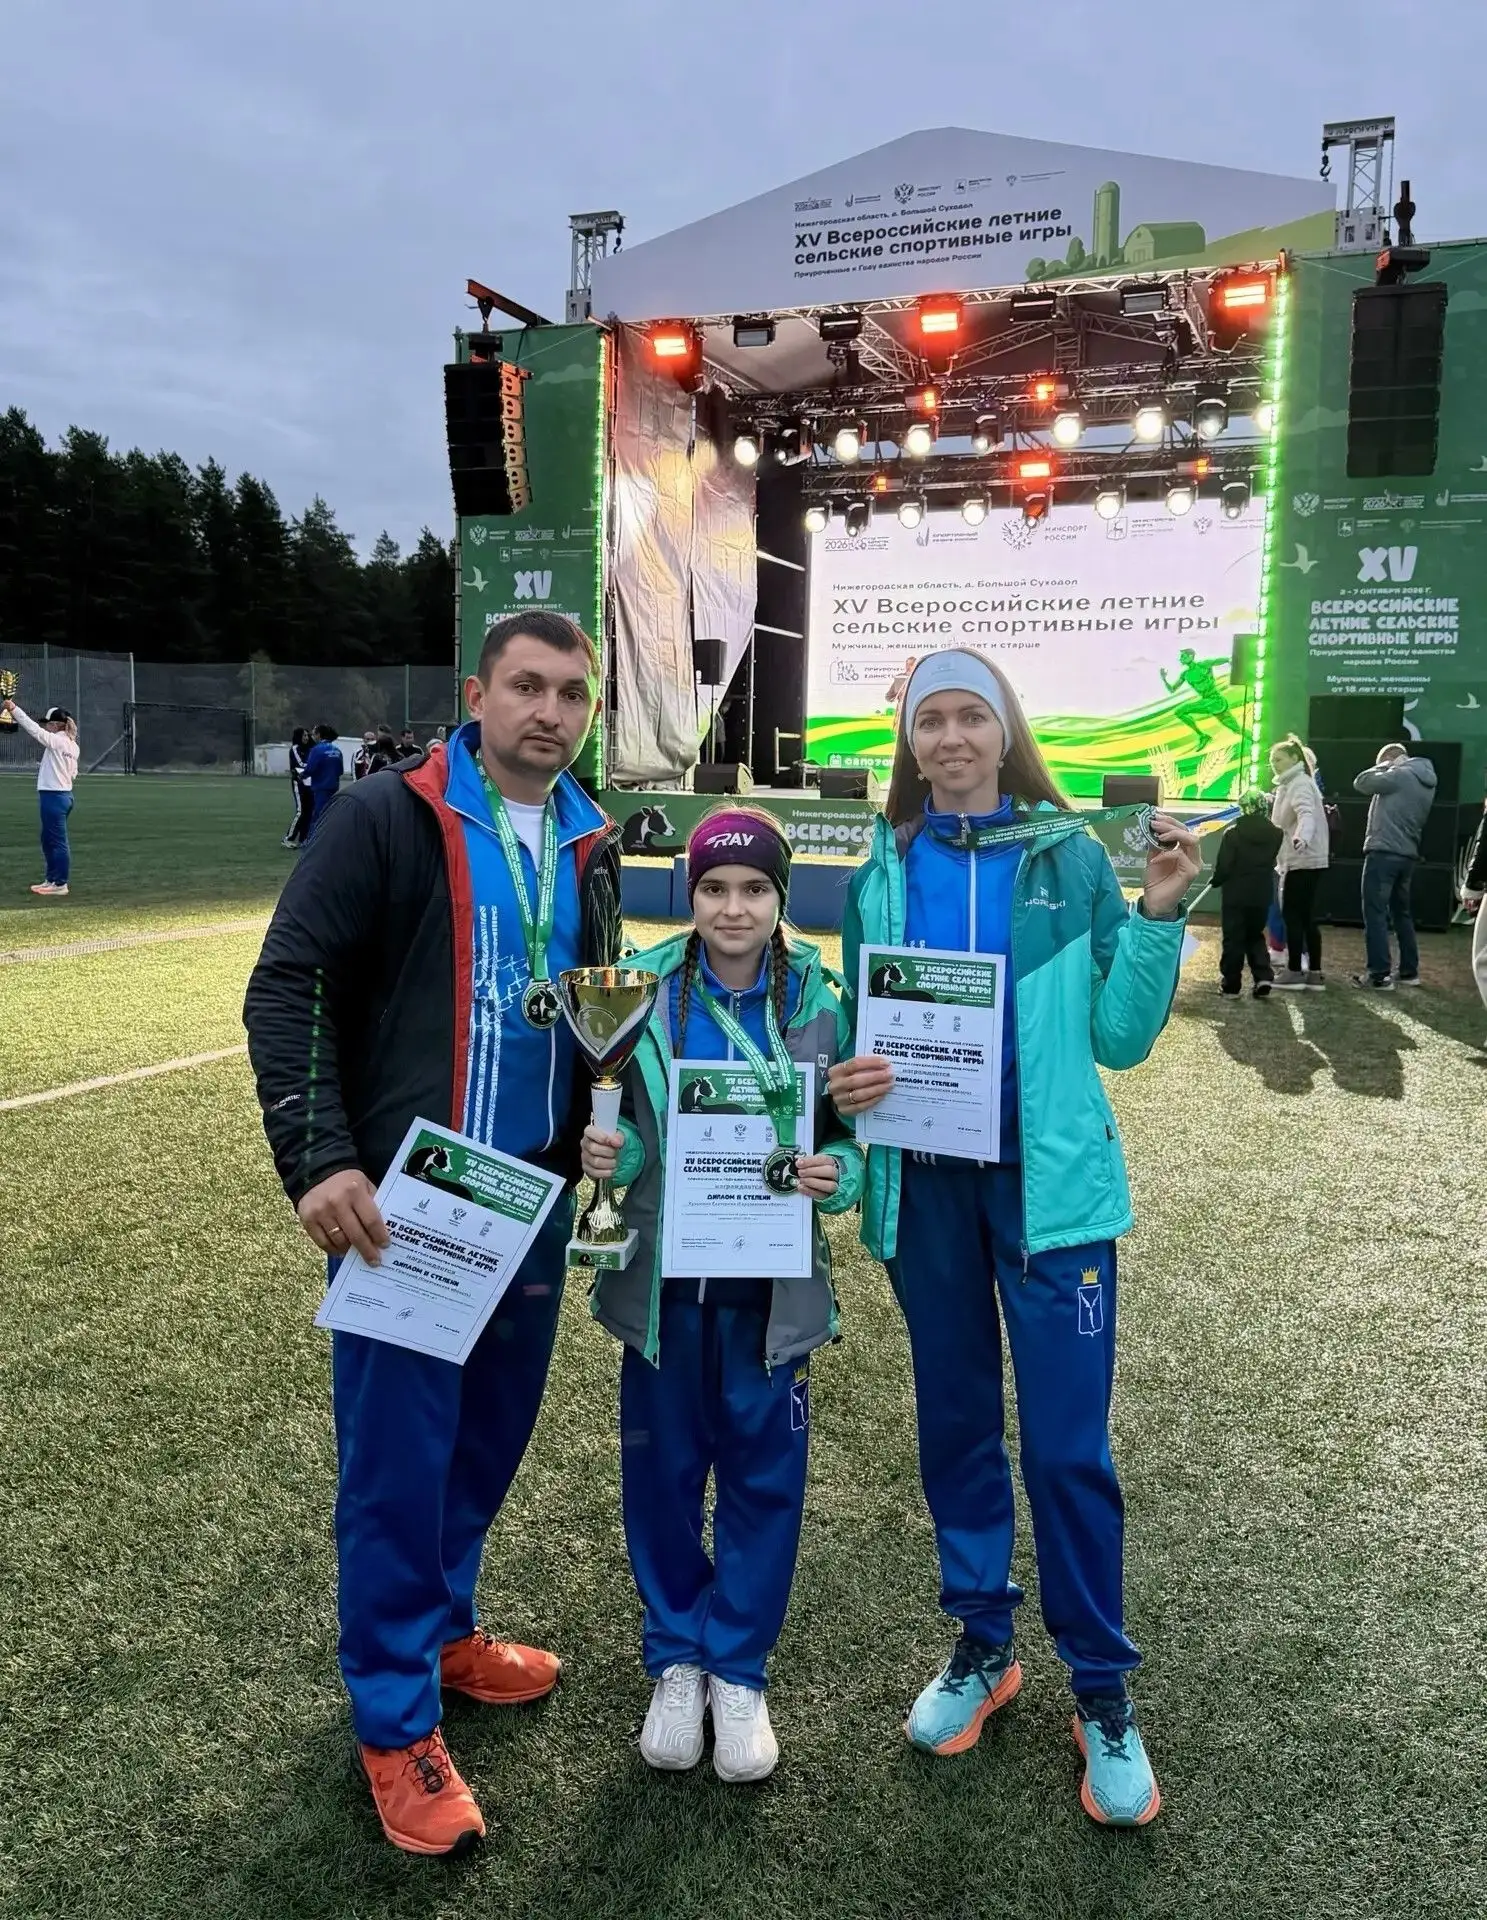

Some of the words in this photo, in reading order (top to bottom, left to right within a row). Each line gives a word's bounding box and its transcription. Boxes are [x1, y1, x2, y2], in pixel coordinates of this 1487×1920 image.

[795, 217, 855, 228] Нижегородская
[857, 213, 889, 222] область,
[901, 205, 936, 216] Большой
[939, 203, 973, 213] Суходол
[795, 232, 821, 248] XV
[827, 217, 982, 245] Всероссийские
[988, 208, 1062, 227] летние
[795, 245, 883, 265] сельские
[889, 231, 1013, 254] спортивные
[1020, 225, 1072, 242] игры
[794, 267, 850, 278] Приуроченные
[858, 264, 876, 273] Году
[878, 260, 914, 269] единства
[917, 256, 949, 265] народов
[952, 253, 982, 261] России
[1357, 546, 1418, 582] XV
[514, 570, 552, 600] XV
[832, 583, 914, 592] Нижегородская
[917, 581, 962, 590] область,
[978, 577, 1026, 588] Большой
[1030, 577, 1078, 588] Суходол
[833, 599, 868, 614] XV
[877, 594, 1090, 617] Всероссийские
[1100, 595, 1205, 611] летние
[1311, 597, 1459, 614] ВСЕРОССИЙСКИЕ
[832, 620, 952, 634] сельские
[962, 617, 1133, 636] спортивные
[1145, 616, 1219, 634] игры
[1309, 617, 1371, 630] ЛЕТНИЕ
[1376, 615, 1459, 630] СЕЛЬСКИЕ
[1000, 642, 1041, 650] старше
[1308, 632, 1410, 646] СПОРТИВНЫЕ
[1414, 631, 1458, 645] ИГРЫ
[1387, 648, 1411, 656] Году
[792, 810, 867, 820] Нижегородской
[704, 832, 754, 848] RAY
[785, 823, 873, 842] ВСЕРОСС
[919, 973, 949, 982] ЛЕТНИЕ
[951, 975, 991, 986] СЕЛЬСКИЕ
[927, 965, 991, 977] ВСЕРОССИЙСКИЕ
[916, 981, 966, 992] СПОРТИВНЫЕ
[969, 985, 991, 994] ИГРЫ
[873, 1048, 908, 1058] СЕЛЬСКИЕ
[912, 1052, 960, 1063] СПОРТИВНЫЕ
[963, 1056, 984, 1065] ИГРЫ
[874, 1040, 884, 1048] XV
[886, 1041, 949, 1054] ВСЕРОССИЙСКИЕ
[953, 1048, 982, 1057] ЛЕТНИЕ
[896, 1076, 923, 1084] ДИПЛОМ
[931, 1079, 959, 1088] СТЕПЕНИ
[697, 1157, 761, 1165] ВСЕРОССИЙСКИЕ
[465, 1167, 499, 1186] ЛЕТНИЕ
[498, 1181, 541, 1203] СЕЛЬСКИЕ
[476, 1162, 546, 1195] ВСЕРОССИЙСКИЕ
[457, 1174, 513, 1201] СПОРТИВНЫЕ
[512, 1196, 537, 1211] ИГРЫ
[384, 1219, 396, 1228] XV
[397, 1224, 467, 1253] ВСЕРОССИЙСКИЕ
[467, 1249, 500, 1265] ЛЕТНИЕ
[385, 1228, 421, 1245] ЛЬСКИЕ
[421, 1241, 474, 1264] СПОРТИВНЫЕ
[473, 1260, 497, 1273] ИГРЫ
[600, 1255, 608, 1263] 2
[391, 1259, 423, 1274] ДИПЛОМ
[429, 1273, 459, 1286] СТЕПЕНИ
